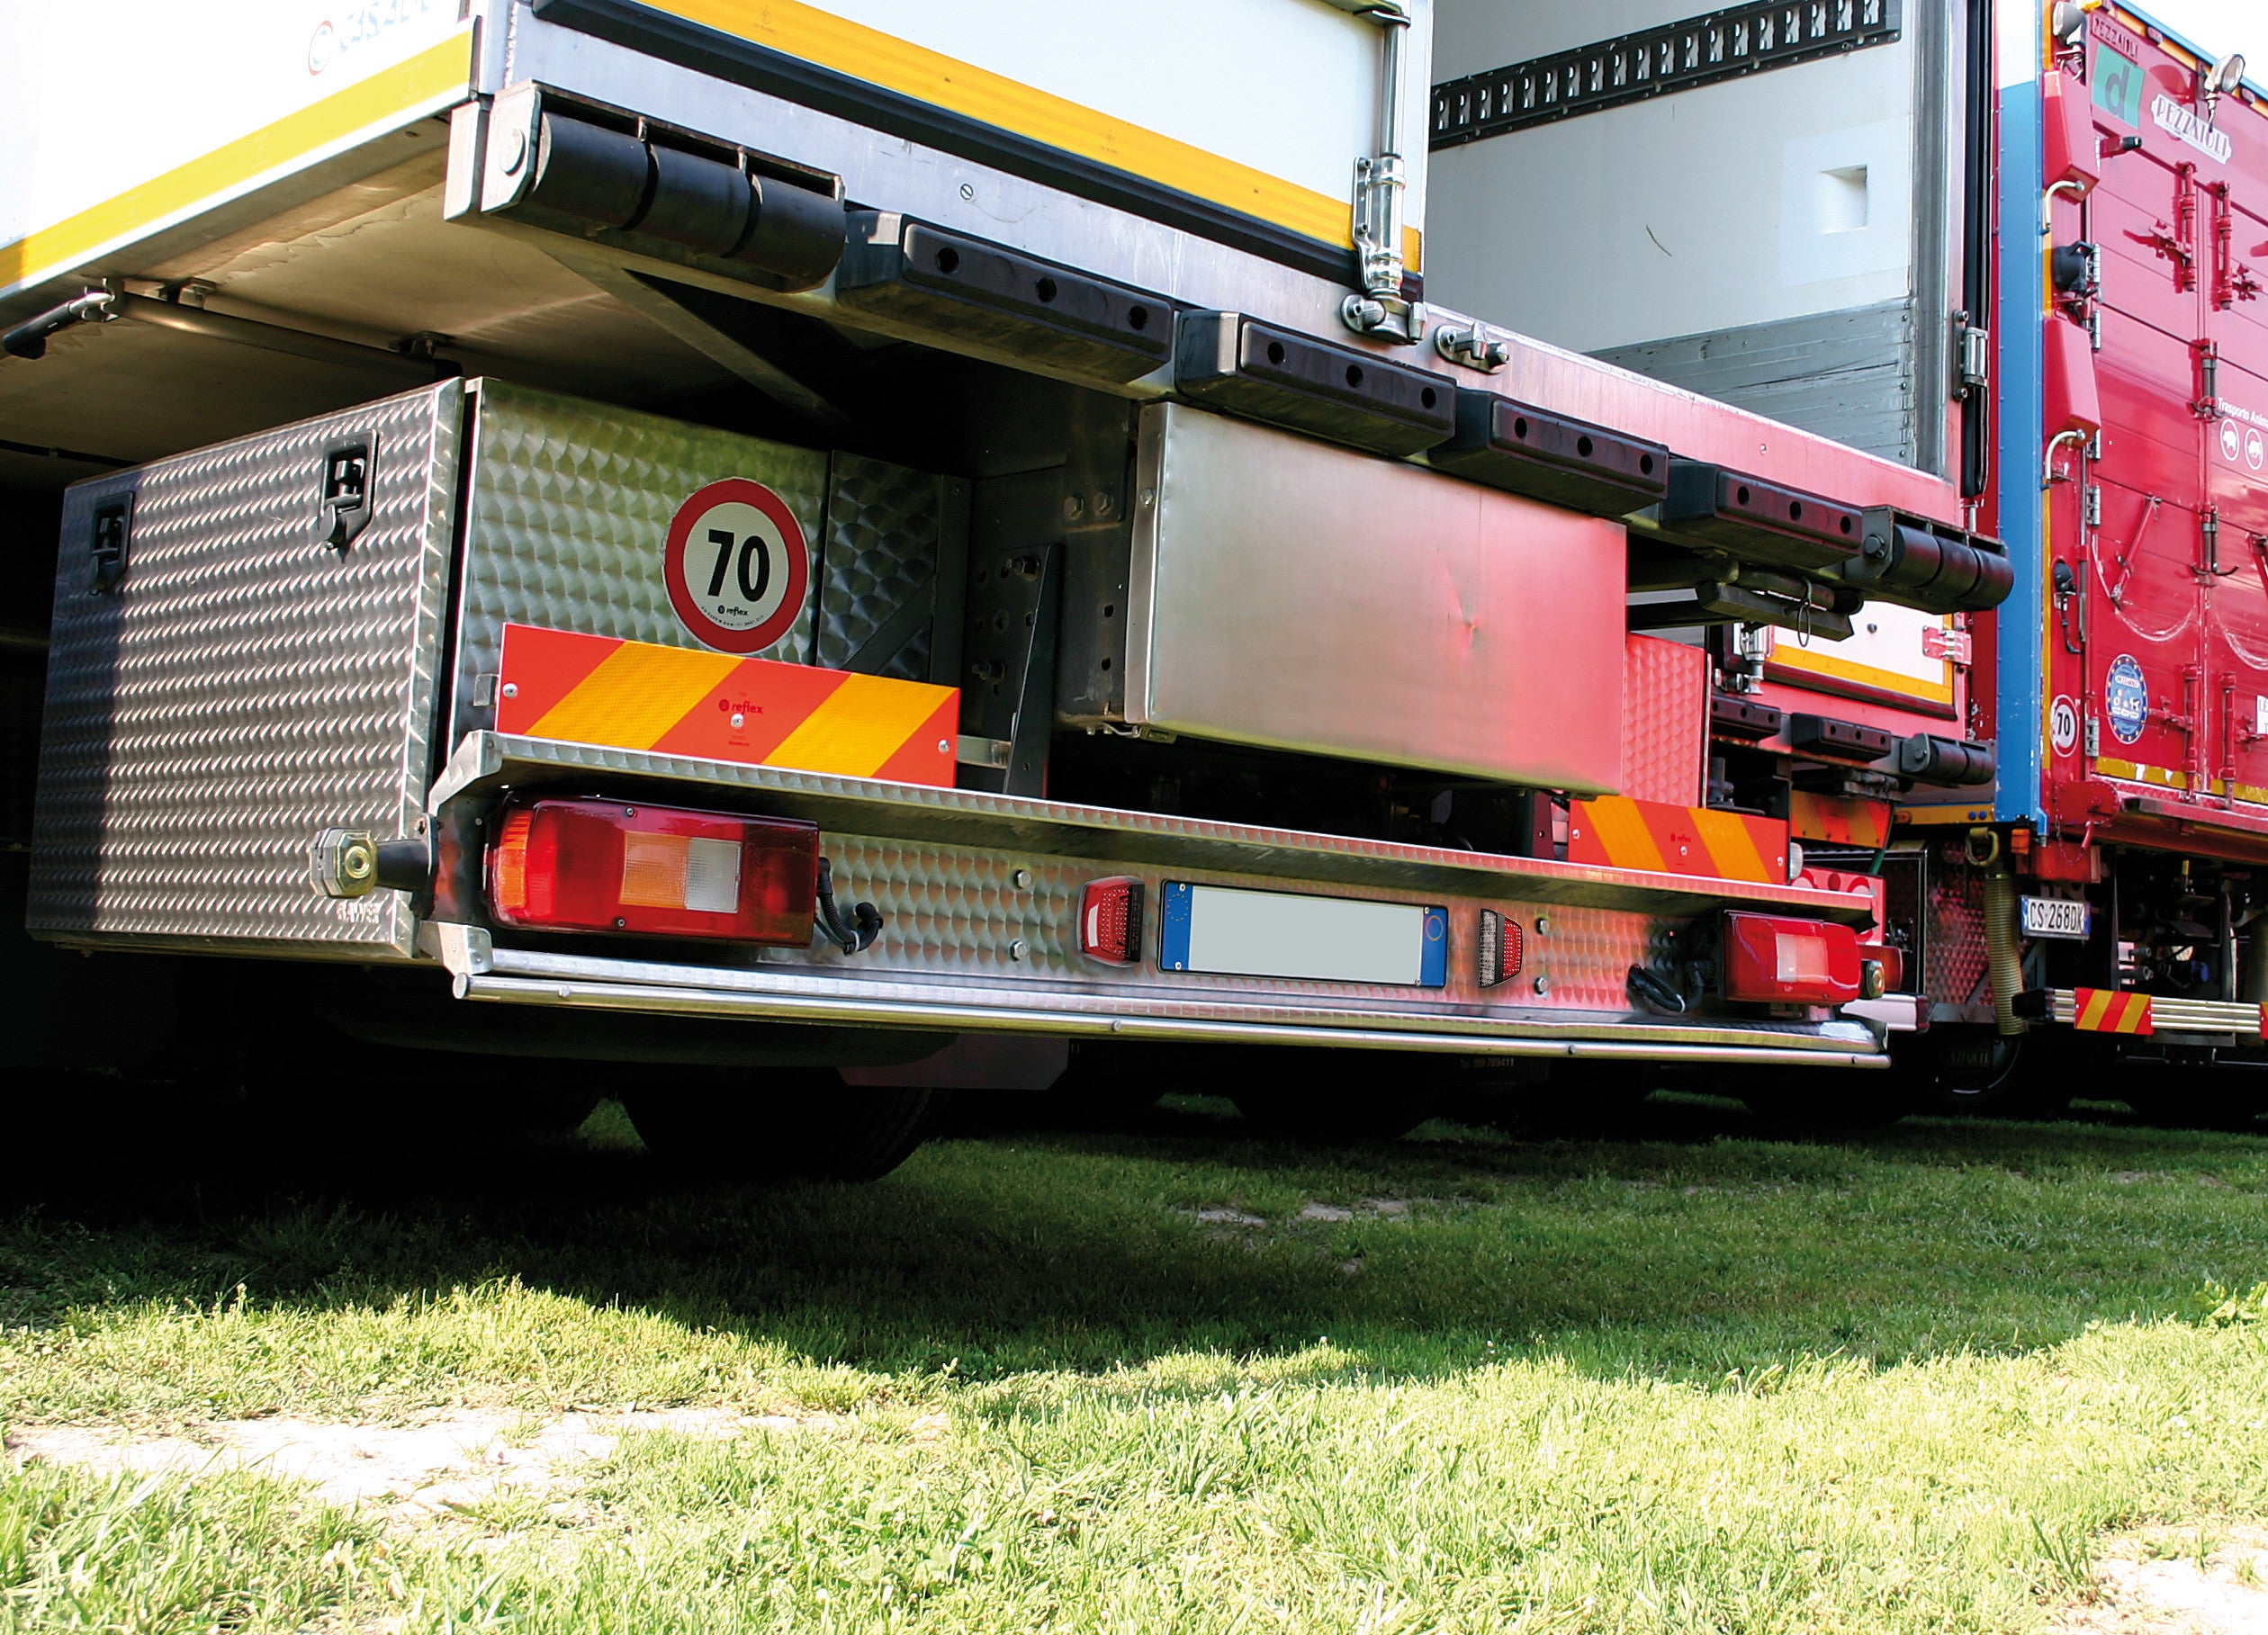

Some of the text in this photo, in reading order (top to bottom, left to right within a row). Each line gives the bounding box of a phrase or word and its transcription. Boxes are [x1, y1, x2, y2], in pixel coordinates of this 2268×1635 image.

[2105, 64, 2130, 121] d
[2156, 94, 2228, 157] PEZZAIOLI
[707, 529, 770, 603] 70
[726, 606, 749, 617] reflex
[731, 700, 763, 715] reflex
[2057, 712, 2072, 737] 70
[2030, 902, 2044, 929] CS
